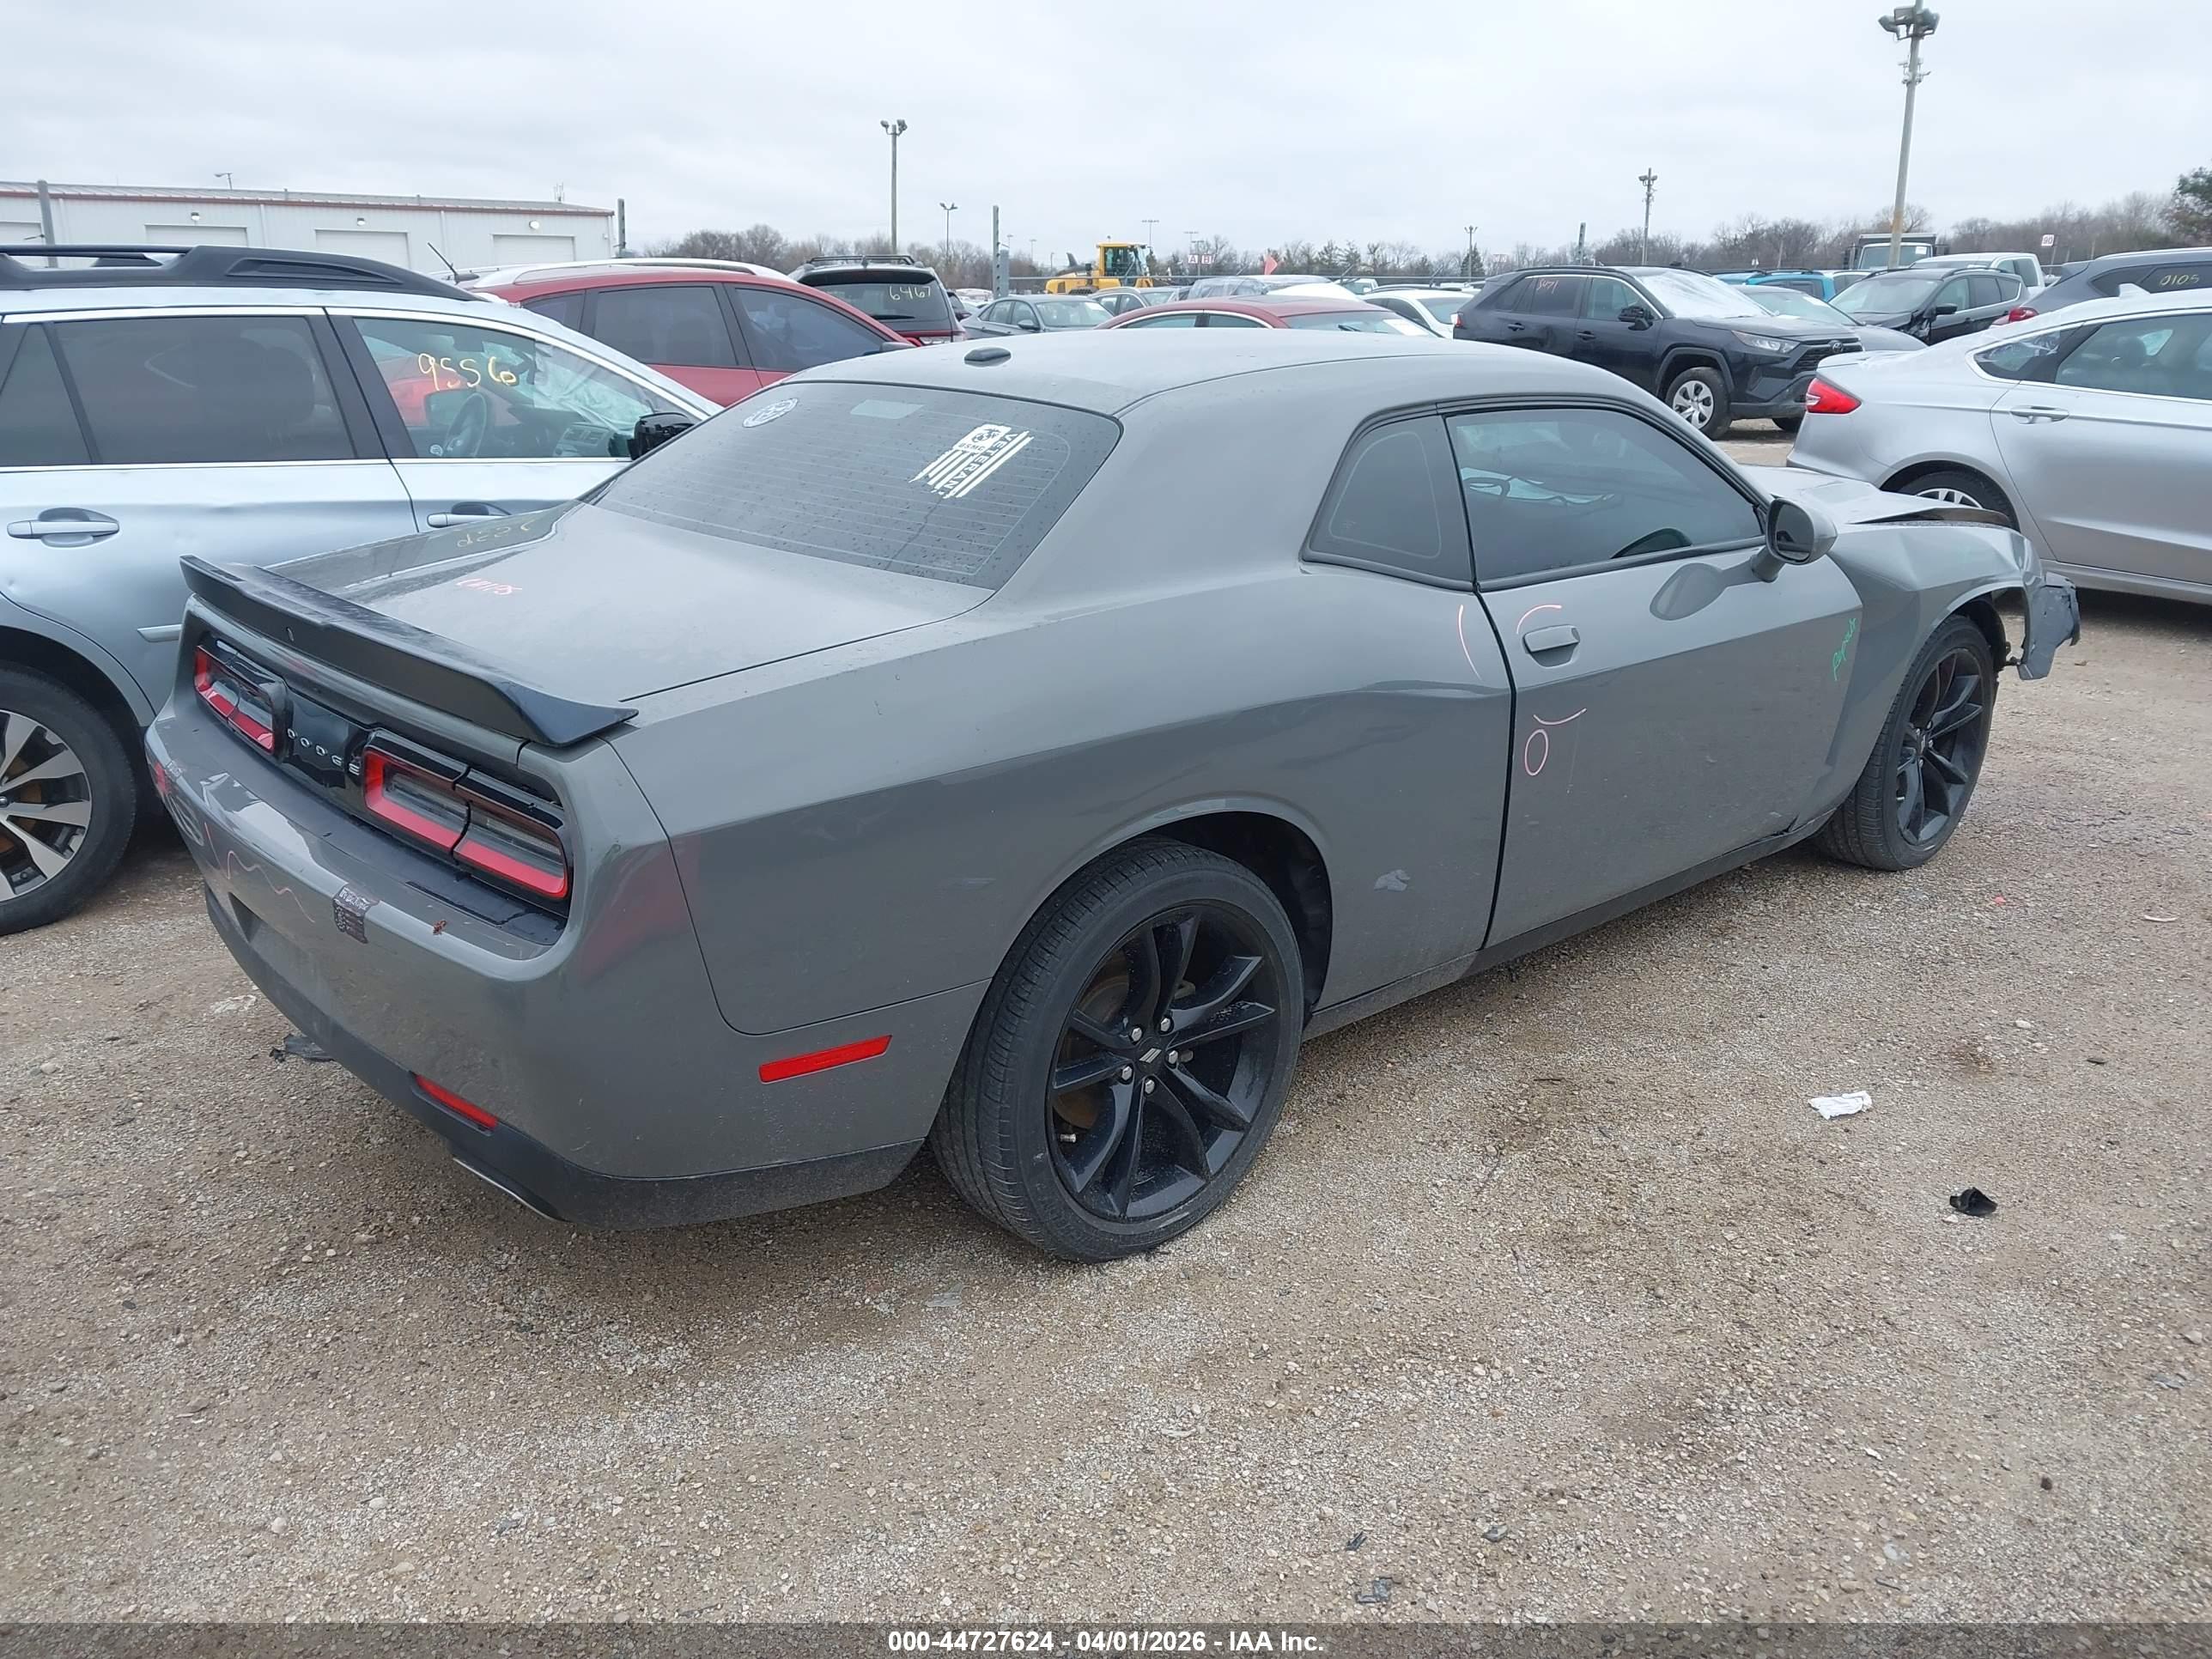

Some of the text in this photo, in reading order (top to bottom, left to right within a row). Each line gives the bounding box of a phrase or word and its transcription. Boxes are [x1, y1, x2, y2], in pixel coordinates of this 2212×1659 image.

[889, 285, 931, 300] 6467
[418, 353, 517, 392] 9556
[944, 433, 1019, 490] VETERAN
[958, 442, 986, 452] USMC
[287, 728, 360, 776] DODGE
